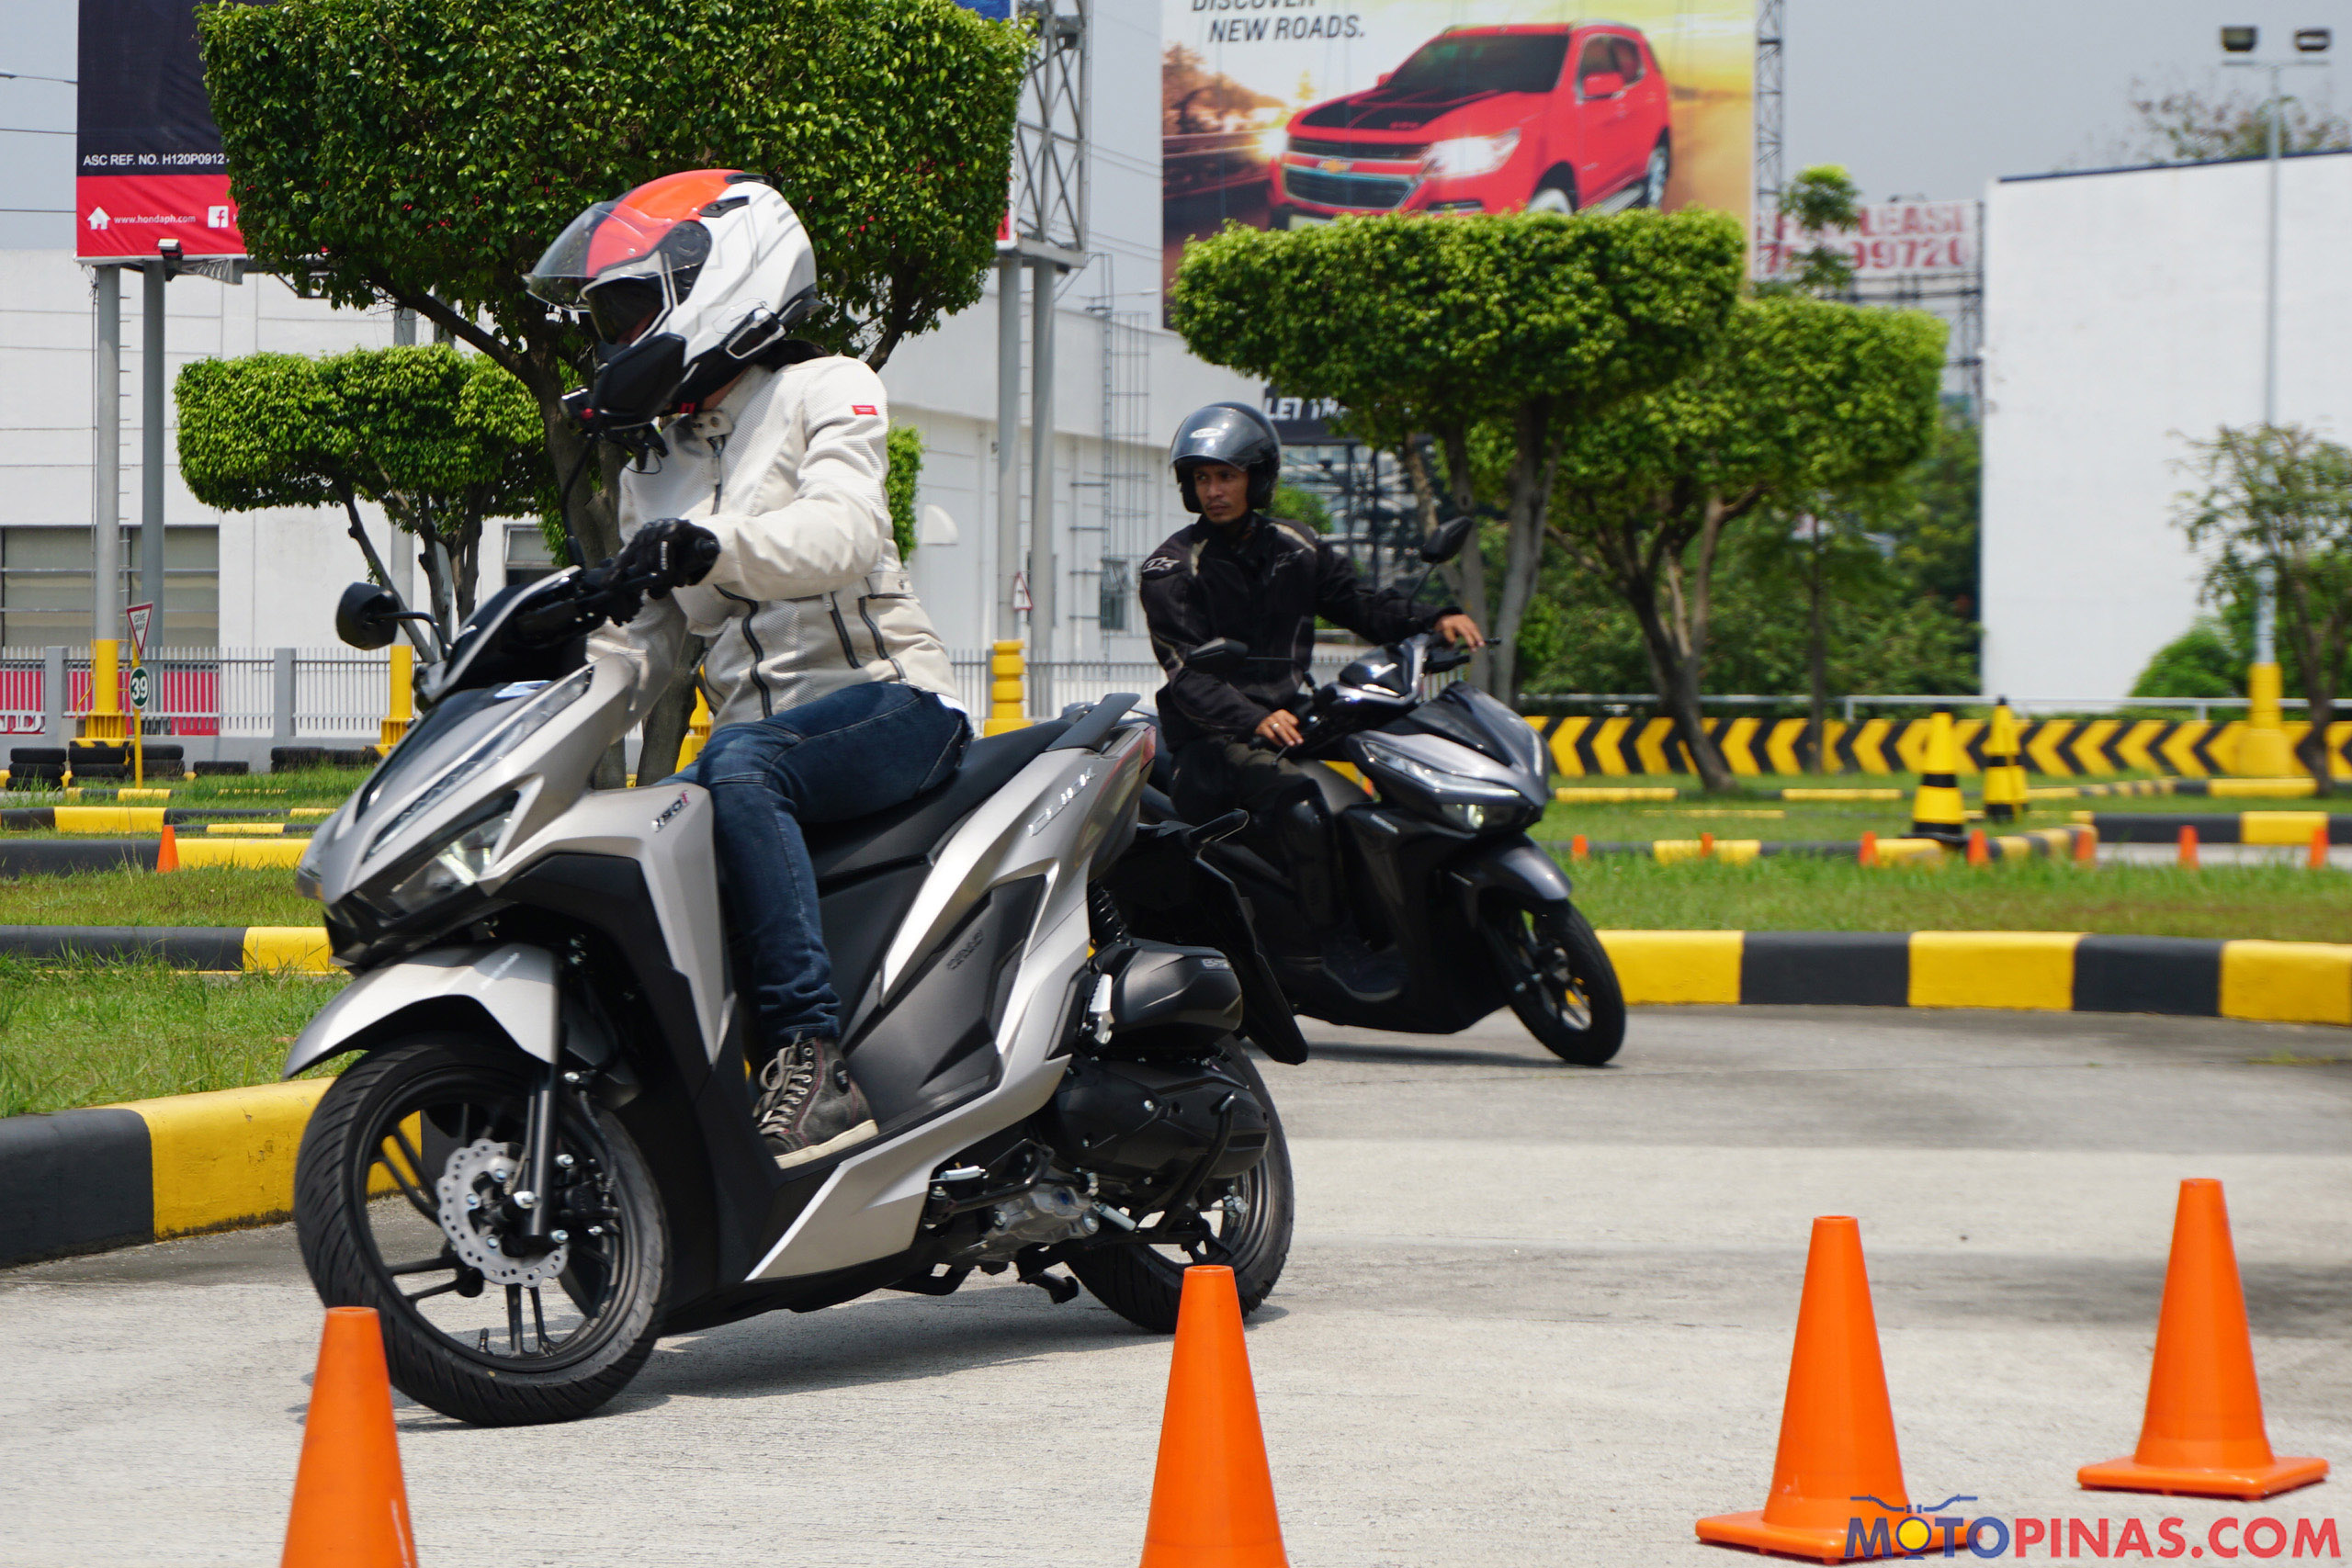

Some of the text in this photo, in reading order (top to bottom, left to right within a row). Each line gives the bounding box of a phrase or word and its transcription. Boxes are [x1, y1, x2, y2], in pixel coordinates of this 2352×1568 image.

[1208, 15, 1364, 43] NEW ROADS.
[83, 152, 230, 166] ASC REF. NO. H120P0912
[114, 214, 197, 225] www.hondaph.com
[131, 676, 148, 700] 39
